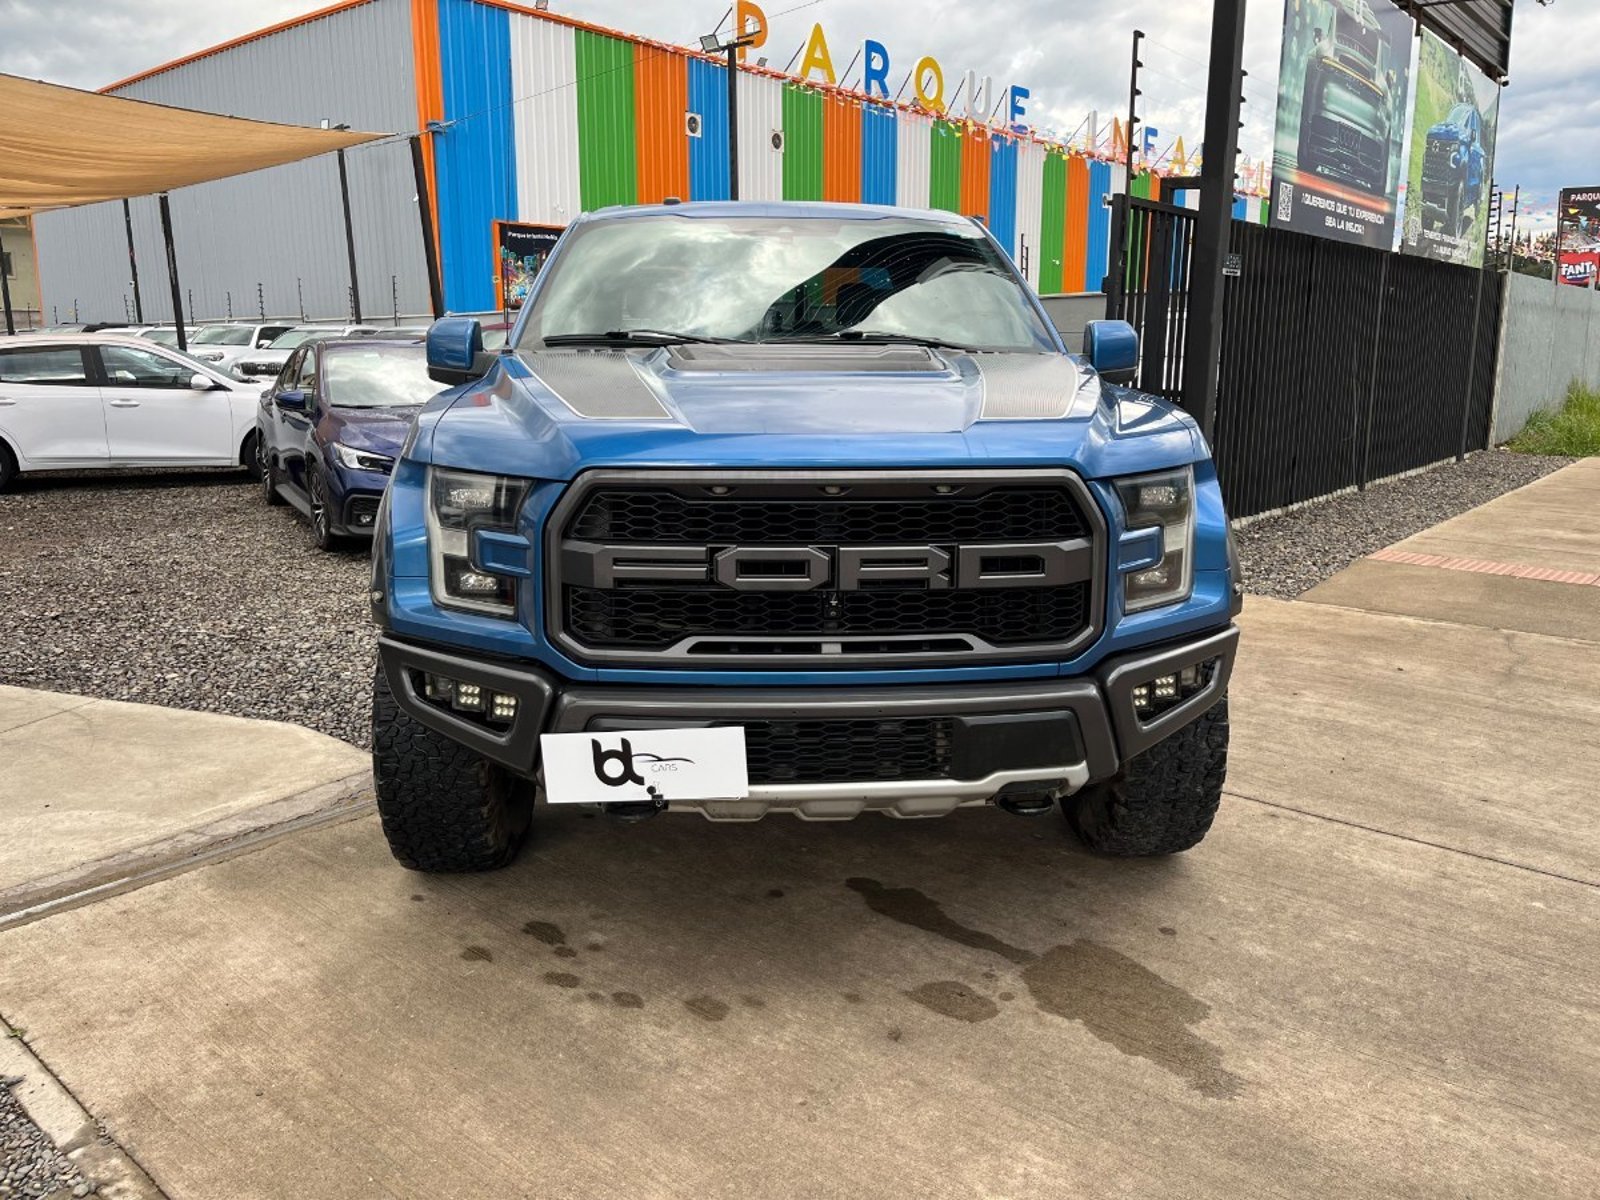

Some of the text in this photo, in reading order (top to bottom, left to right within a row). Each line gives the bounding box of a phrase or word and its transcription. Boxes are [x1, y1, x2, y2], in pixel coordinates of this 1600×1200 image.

[732, 0, 1030, 135] PARQUE
[1335, 202, 1348, 216] QUE
[1348, 206, 1356, 218] TU
[1337, 219, 1345, 230] LA
[1561, 261, 1597, 276] FANTA
[592, 543, 1078, 590] FORD
[651, 763, 678, 773] CARS
